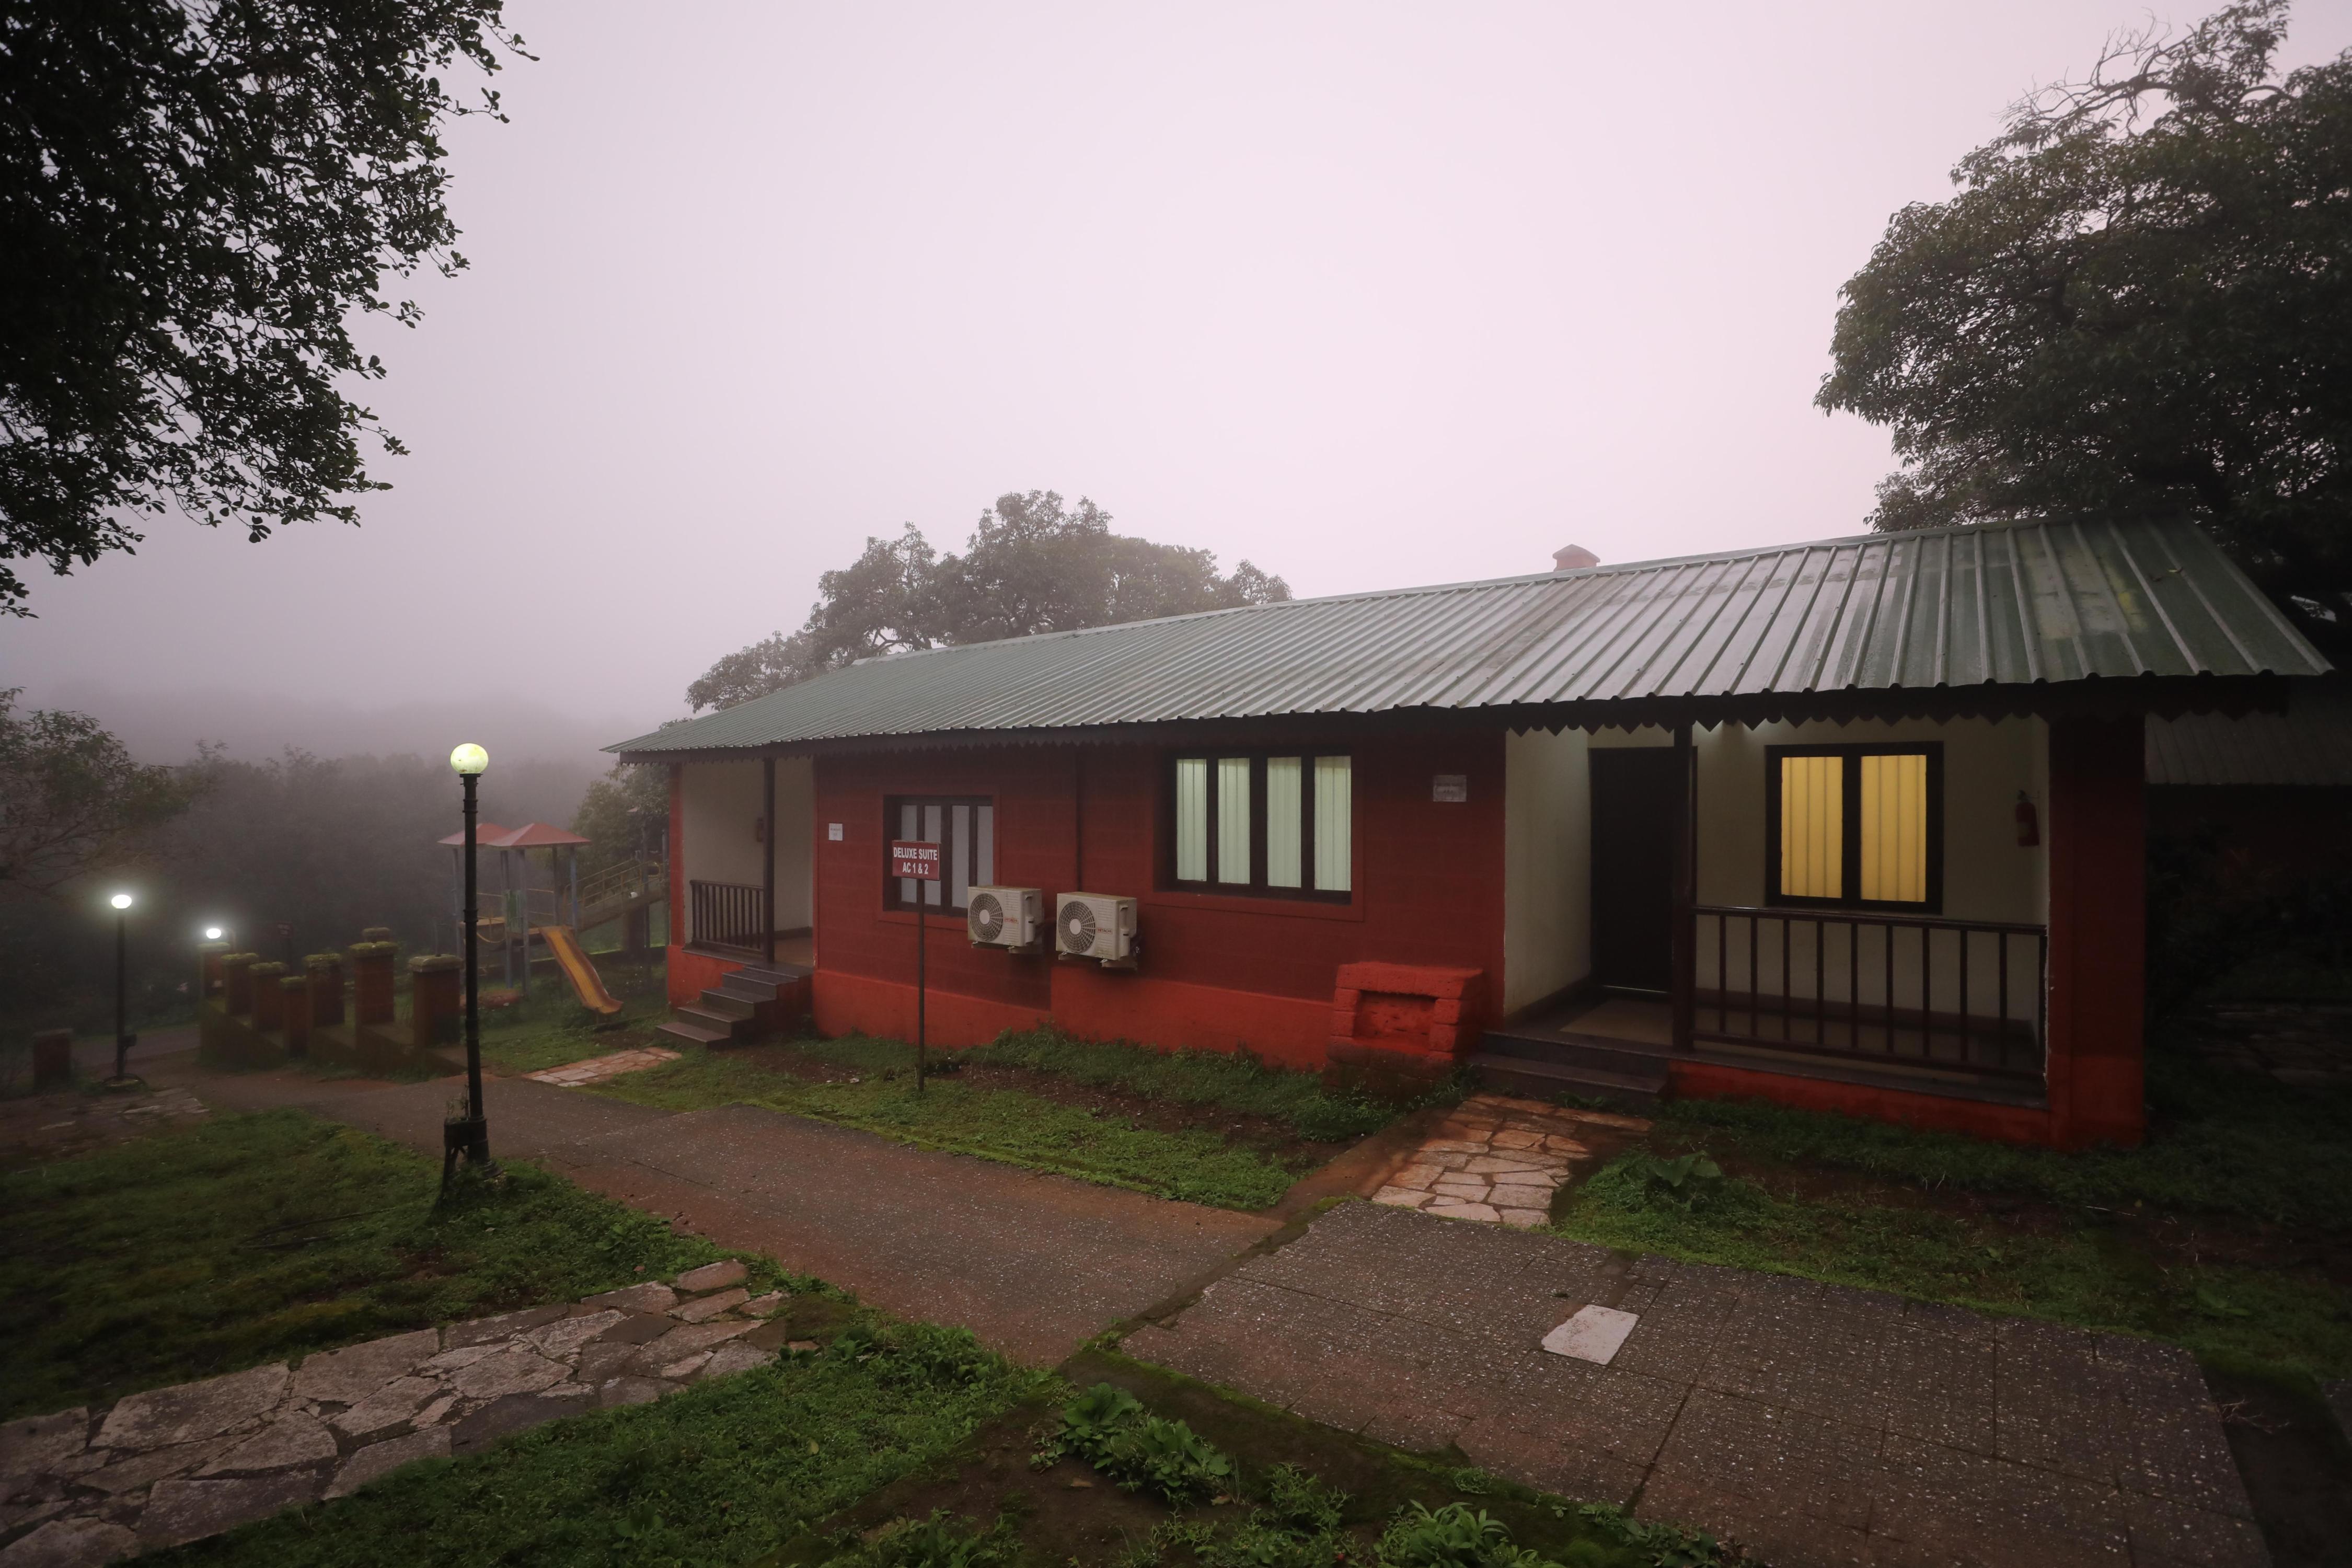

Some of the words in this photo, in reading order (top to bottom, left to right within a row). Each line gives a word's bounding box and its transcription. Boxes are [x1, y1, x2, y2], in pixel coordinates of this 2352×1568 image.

[894, 847, 917, 859] DELUXE
[919, 848, 938, 860] SUITE
[902, 862, 911, 873] AC
[913, 862, 916, 873] 1
[918, 863, 923, 874] &
[924, 863, 928, 874] 2
